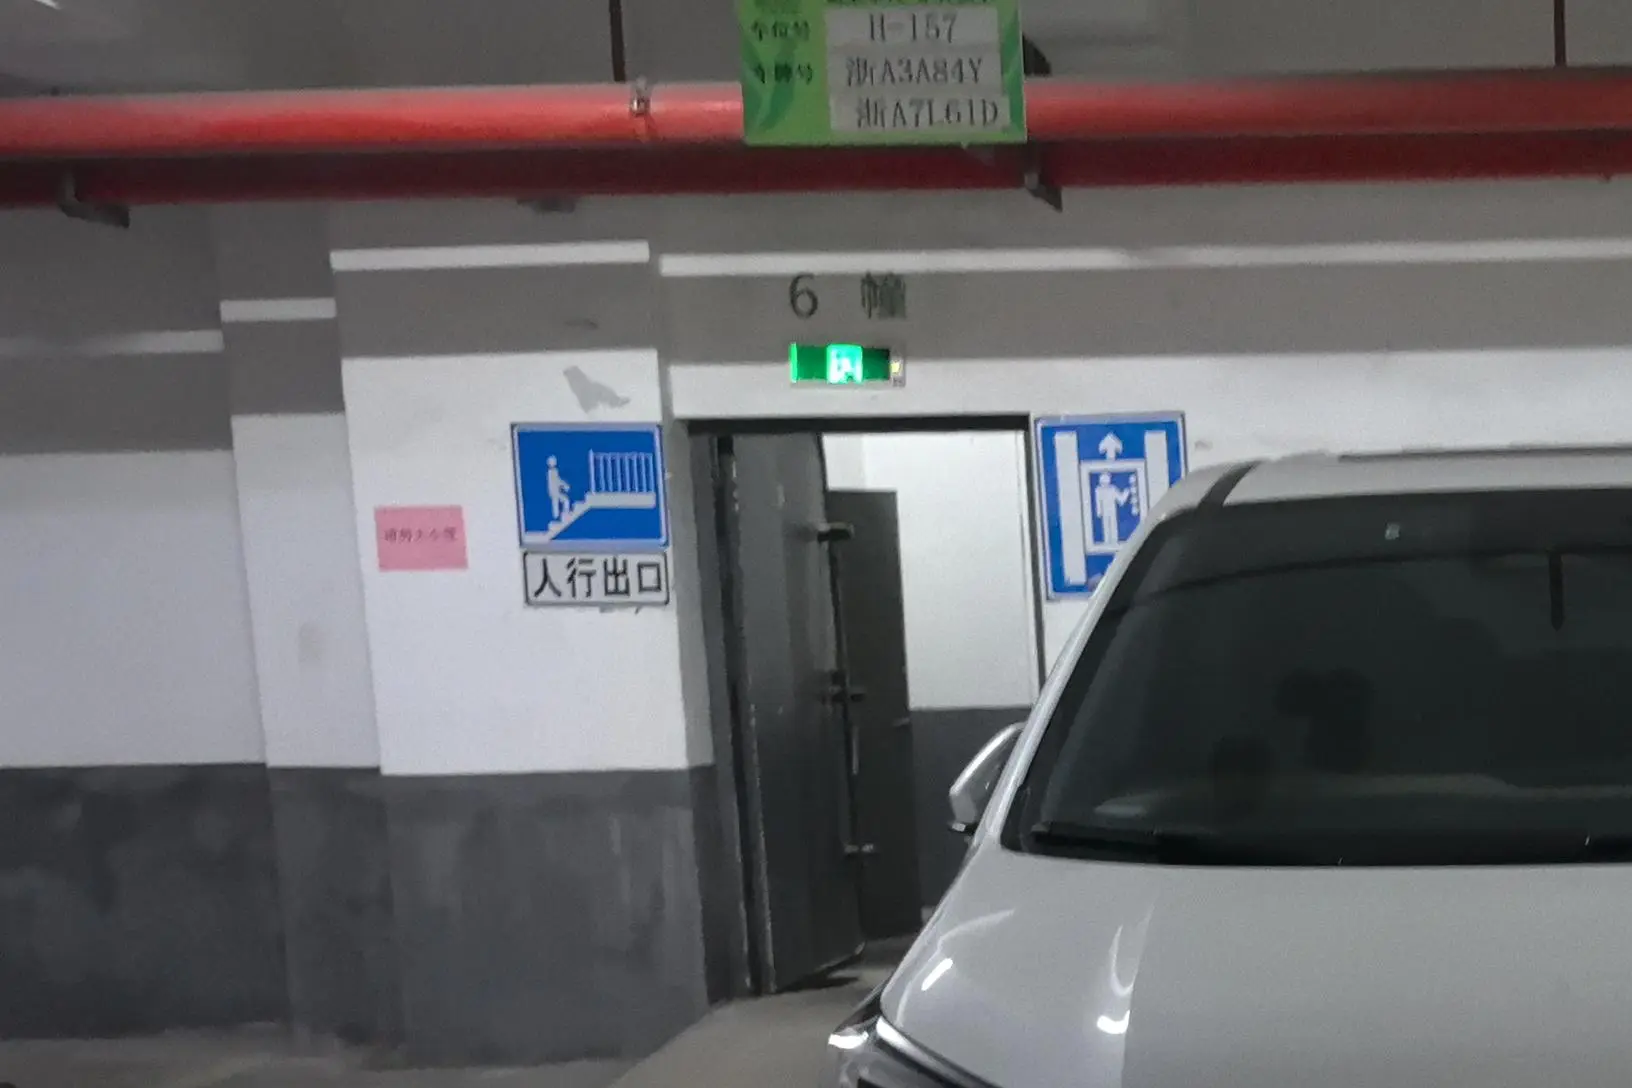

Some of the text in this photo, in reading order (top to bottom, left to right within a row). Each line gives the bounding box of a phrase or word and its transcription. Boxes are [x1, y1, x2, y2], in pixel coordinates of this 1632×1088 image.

[789, 273, 819, 320] 6
[533, 557, 662, 599] 人行出口
